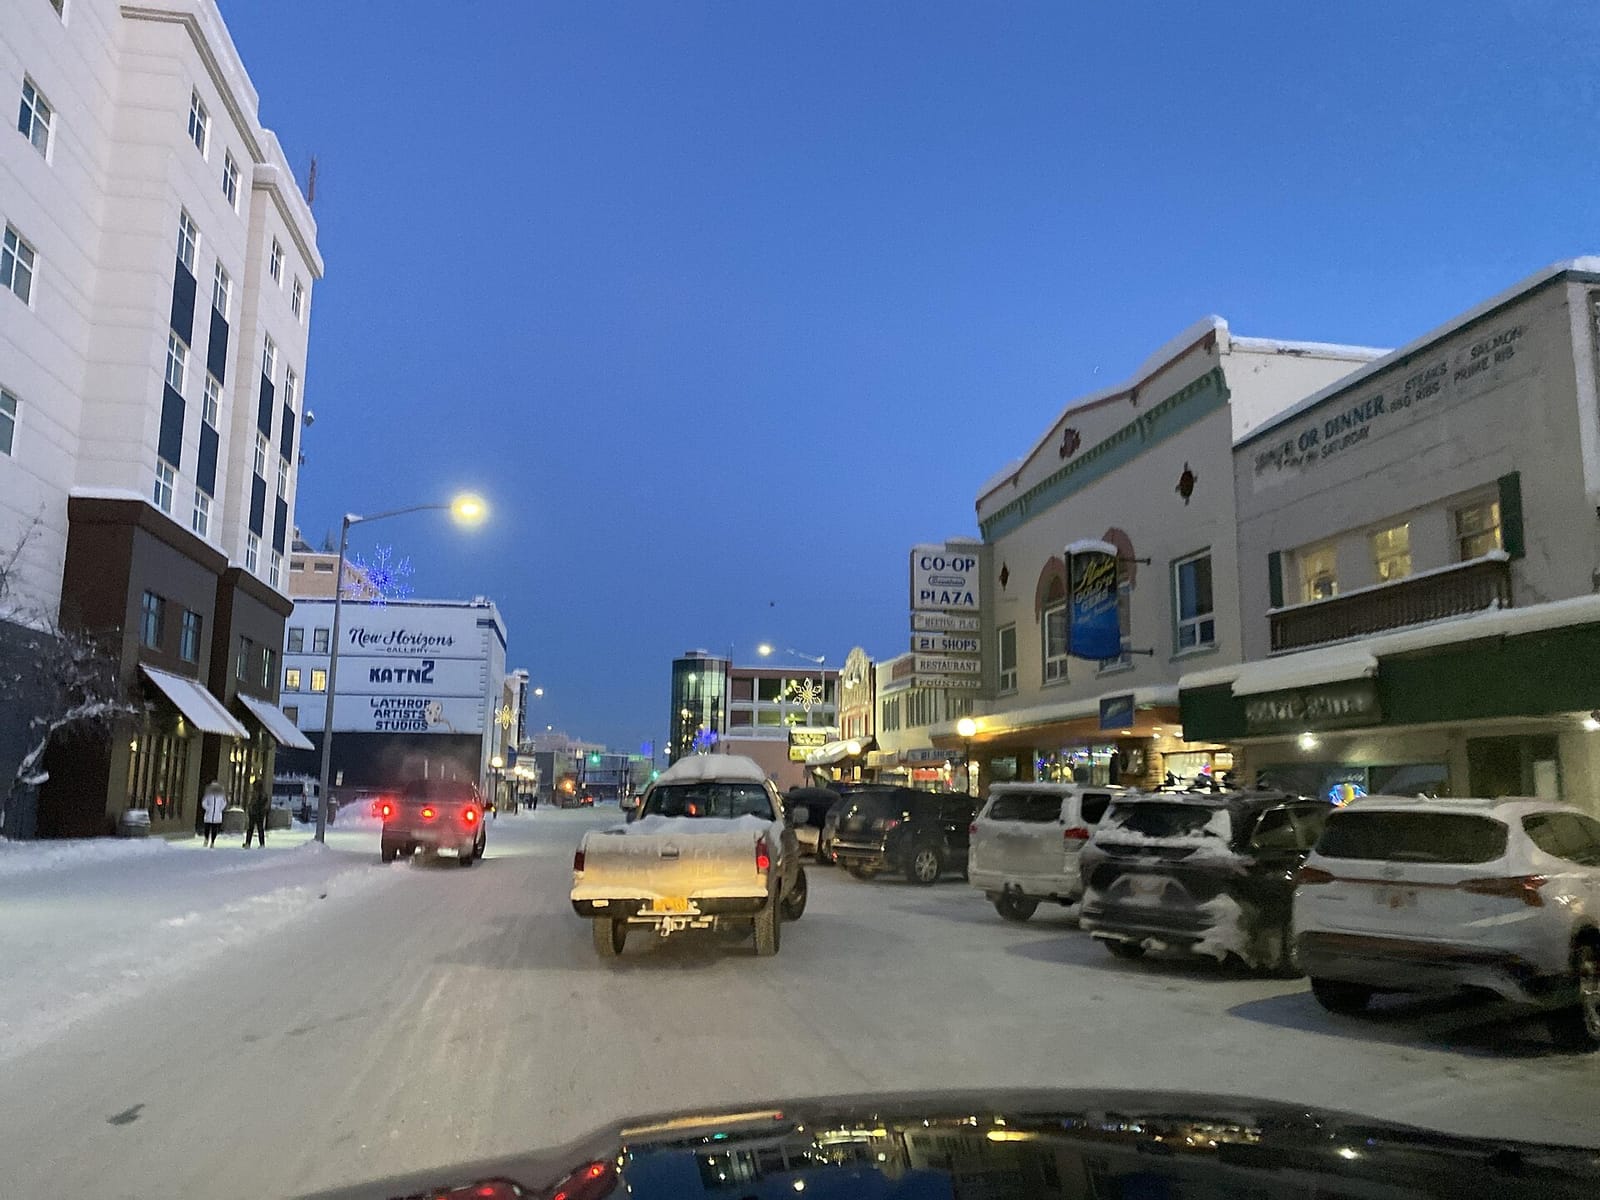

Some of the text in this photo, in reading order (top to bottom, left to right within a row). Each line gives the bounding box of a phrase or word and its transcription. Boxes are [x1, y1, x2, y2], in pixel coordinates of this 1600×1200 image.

[1298, 394, 1385, 452] OR DINNER
[920, 556, 975, 572] CO-OP
[920, 590, 974, 606] PLAZA
[349, 627, 455, 649] New Horizons
[920, 639, 977, 651] 21 SHOPS
[920, 660, 977, 672] RESTAURANT
[373, 709, 426, 719] ARTISTS
[375, 720, 428, 731] STUDIOS
